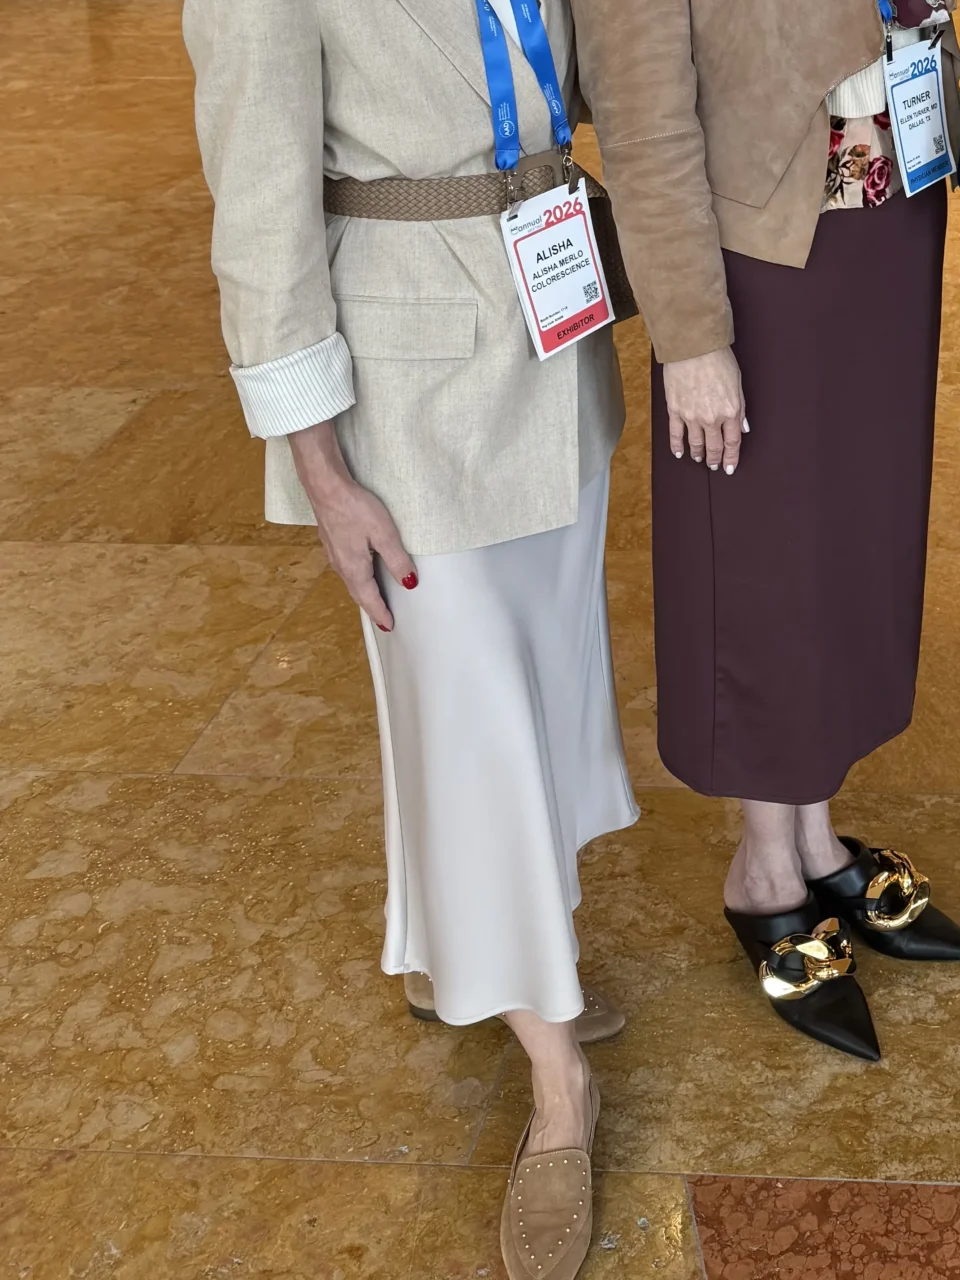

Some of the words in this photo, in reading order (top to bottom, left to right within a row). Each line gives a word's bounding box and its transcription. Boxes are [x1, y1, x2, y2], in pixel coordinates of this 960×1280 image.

[910, 55, 937, 78] 2026
[902, 90, 931, 110] TURNER
[517, 215, 543, 232] annual
[543, 197, 583, 226] 2026
[536, 238, 574, 264] ALISHA
[531, 257, 591, 293] COLORESCIENCE
[532, 263, 559, 281] ALISHA
[558, 249, 584, 268] MERLO
[556, 313, 596, 340] EXHIBITOR
